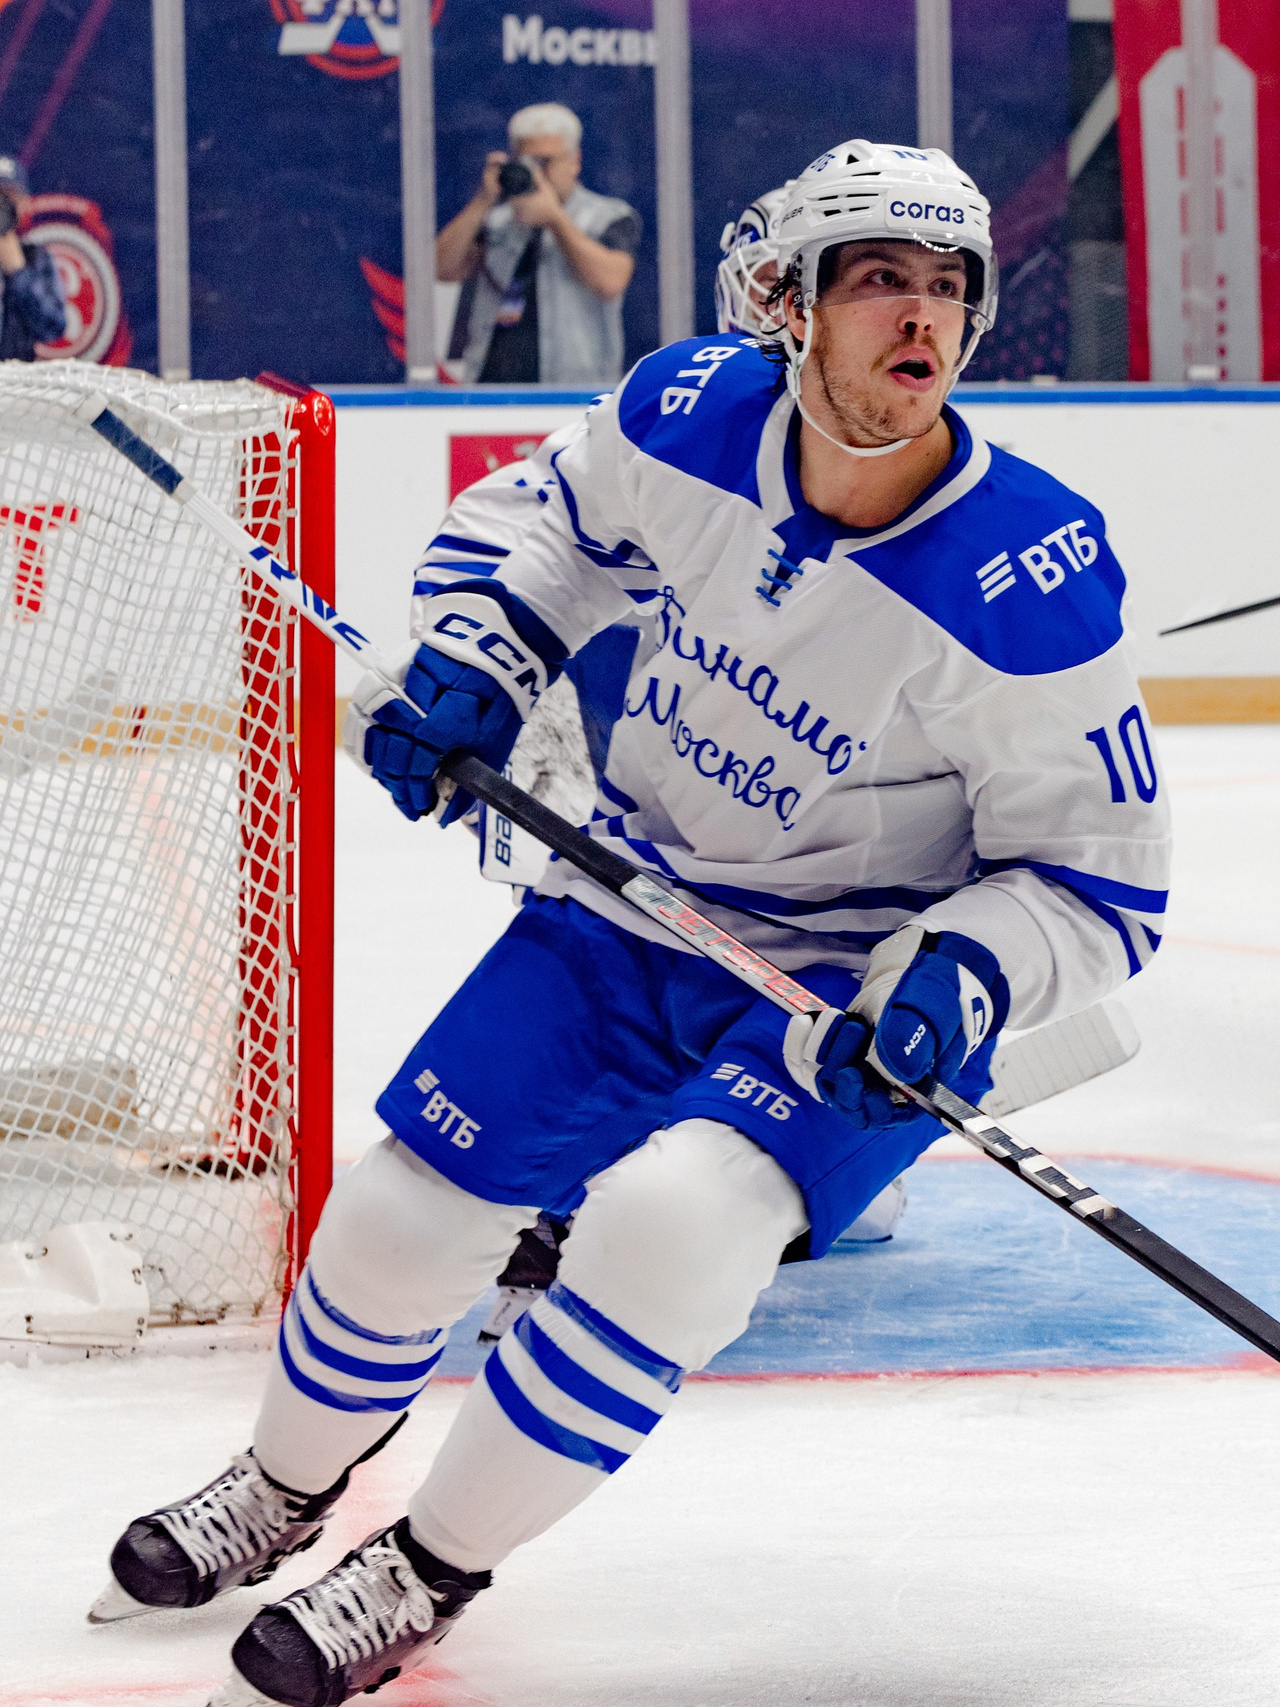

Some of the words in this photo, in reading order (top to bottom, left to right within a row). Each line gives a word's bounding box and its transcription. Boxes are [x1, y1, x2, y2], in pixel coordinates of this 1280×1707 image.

[890, 200, 966, 224] согаз
[660, 346, 742, 416] ВТБ
[1018, 519, 1099, 595] ВТБ
[626, 676, 801, 832] Москва
[1086, 704, 1157, 804] 10
[658, 905, 830, 1013] JETSPEE
[903, 1024, 927, 1056] CCM
[419, 1089, 483, 1150] ВТБ
[727, 1073, 800, 1121] ВТБ
